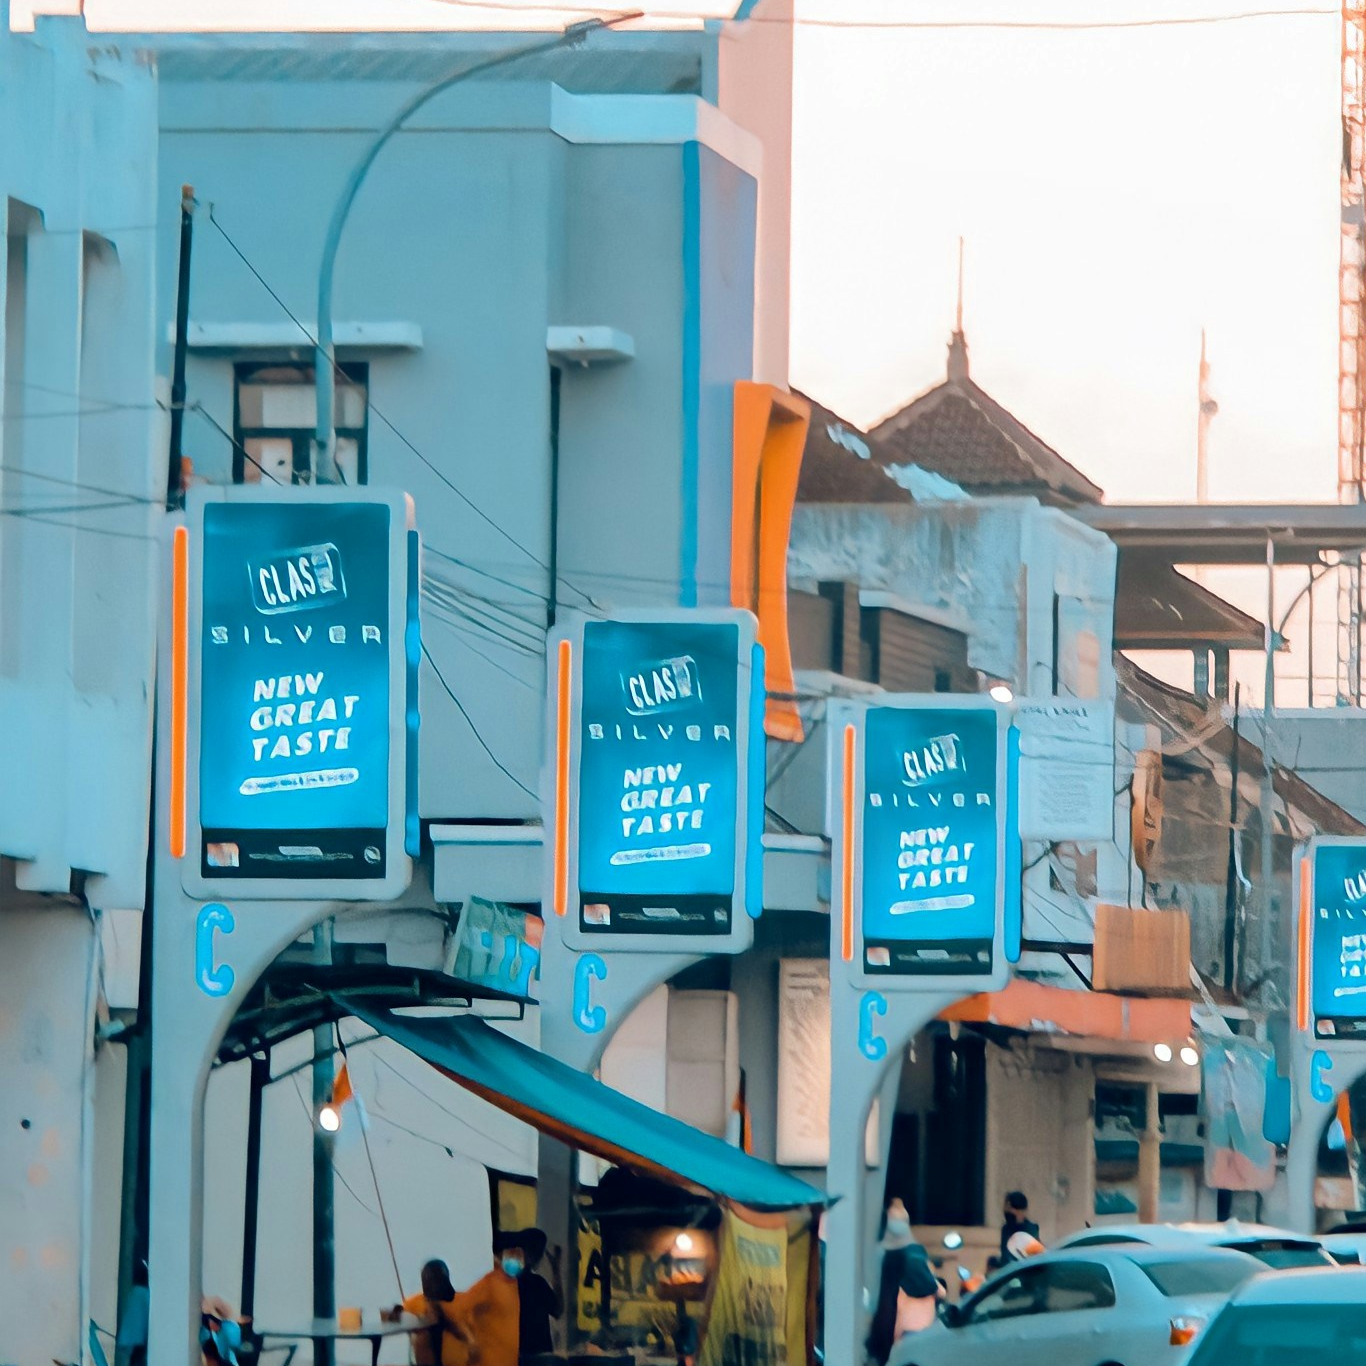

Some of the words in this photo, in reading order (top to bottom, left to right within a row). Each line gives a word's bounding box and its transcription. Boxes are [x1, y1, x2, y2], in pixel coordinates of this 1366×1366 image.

[211, 625, 382, 645] SILVER
[253, 671, 324, 702] NEW
[250, 695, 360, 732] GREAT
[252, 727, 352, 762] TASTE
[623, 763, 683, 789] NEW
[620, 782, 711, 812] GREAT
[622, 809, 704, 837] TASTE
